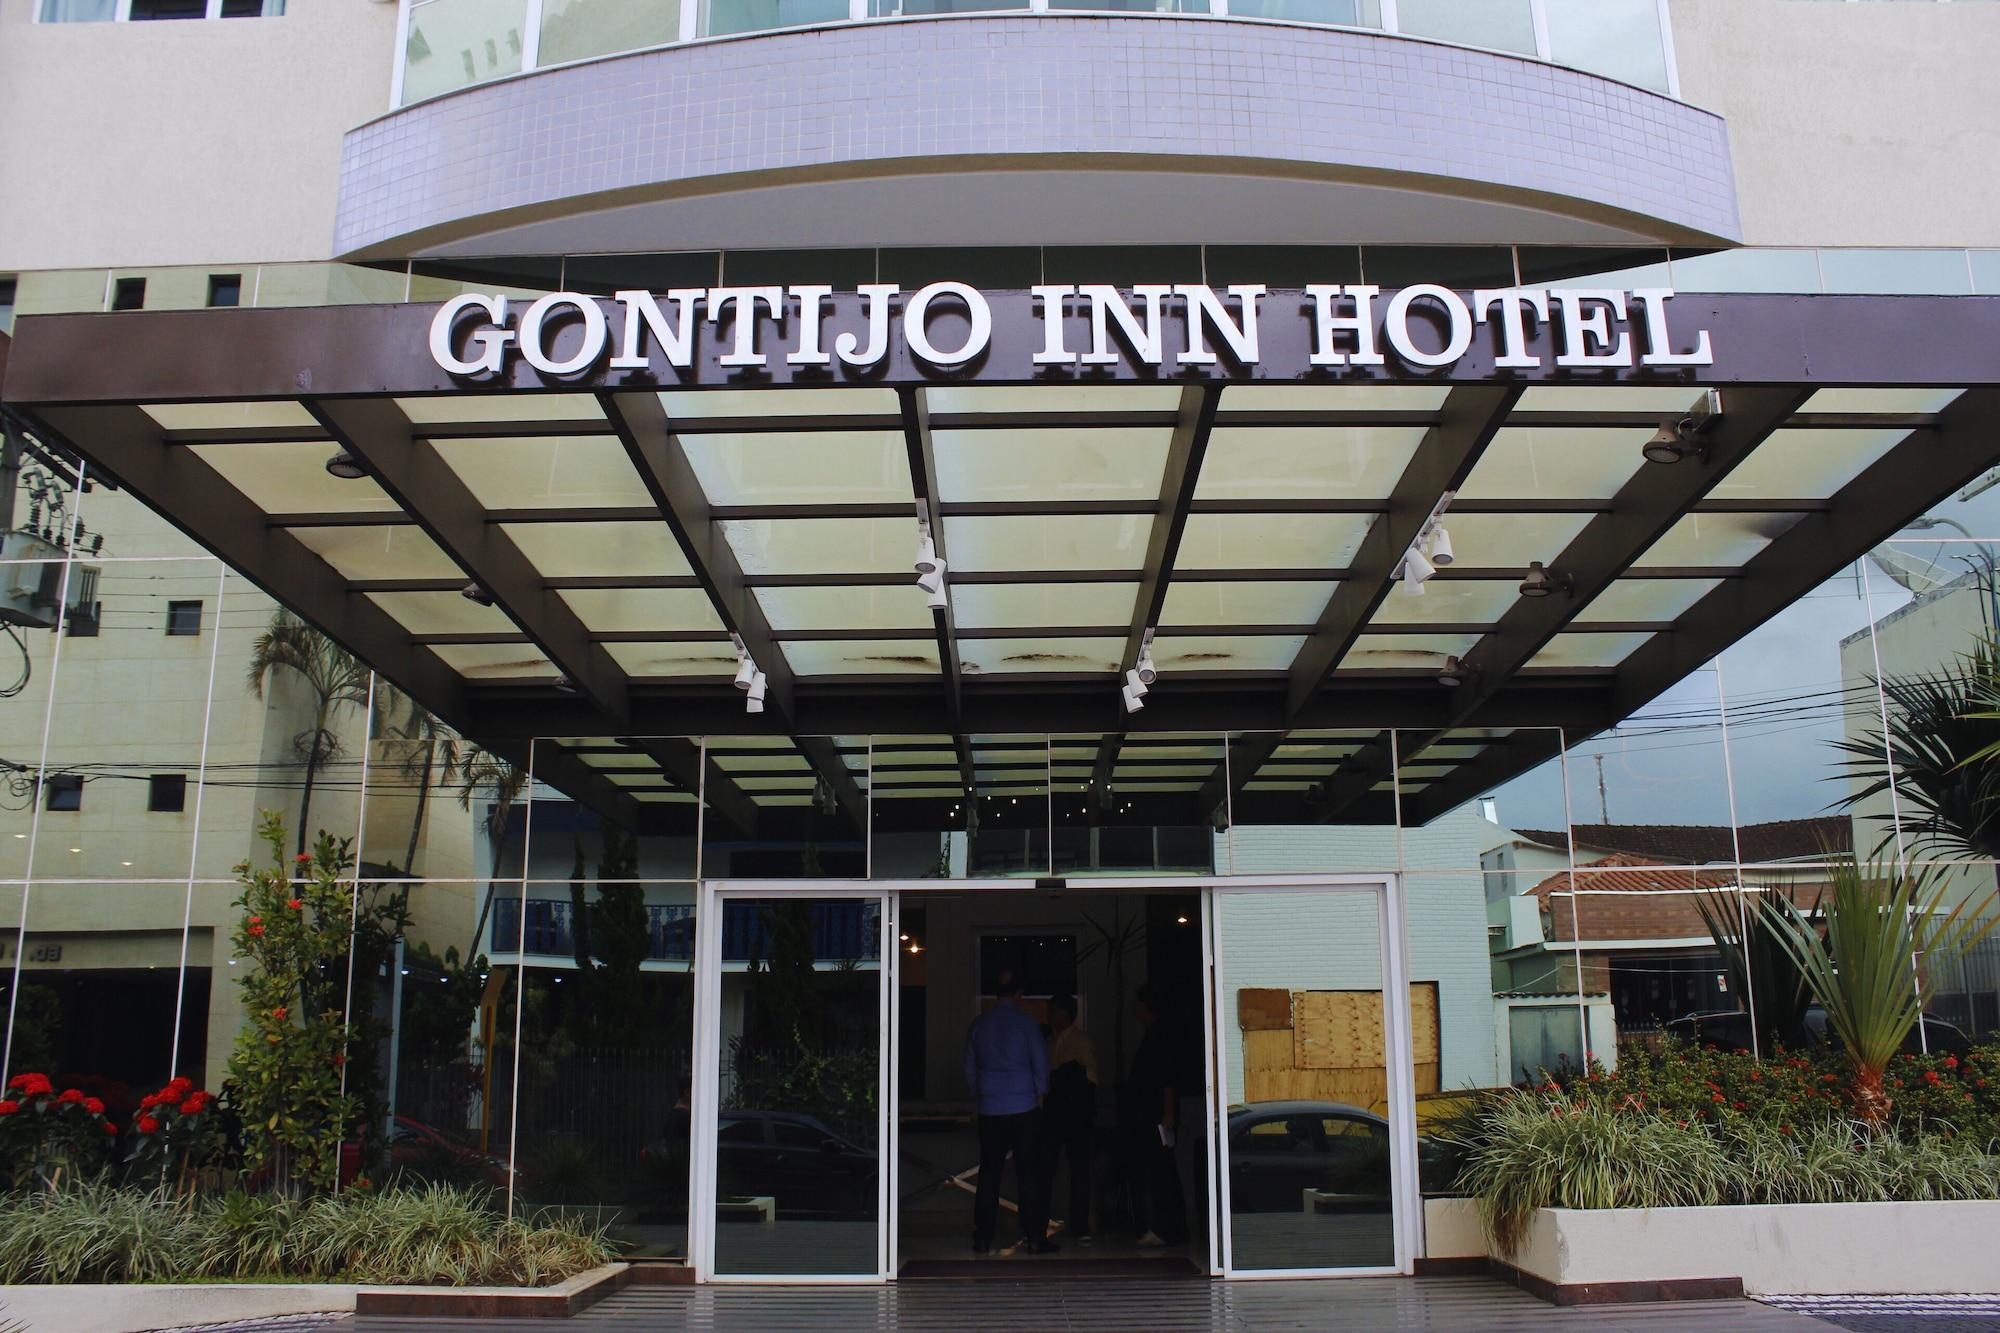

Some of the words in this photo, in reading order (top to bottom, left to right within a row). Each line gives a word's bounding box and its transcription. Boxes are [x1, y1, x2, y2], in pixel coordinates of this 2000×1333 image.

[429, 281, 992, 375] GONTIJO
[1031, 284, 1267, 365] INN
[1306, 283, 1713, 368] HOTEL
